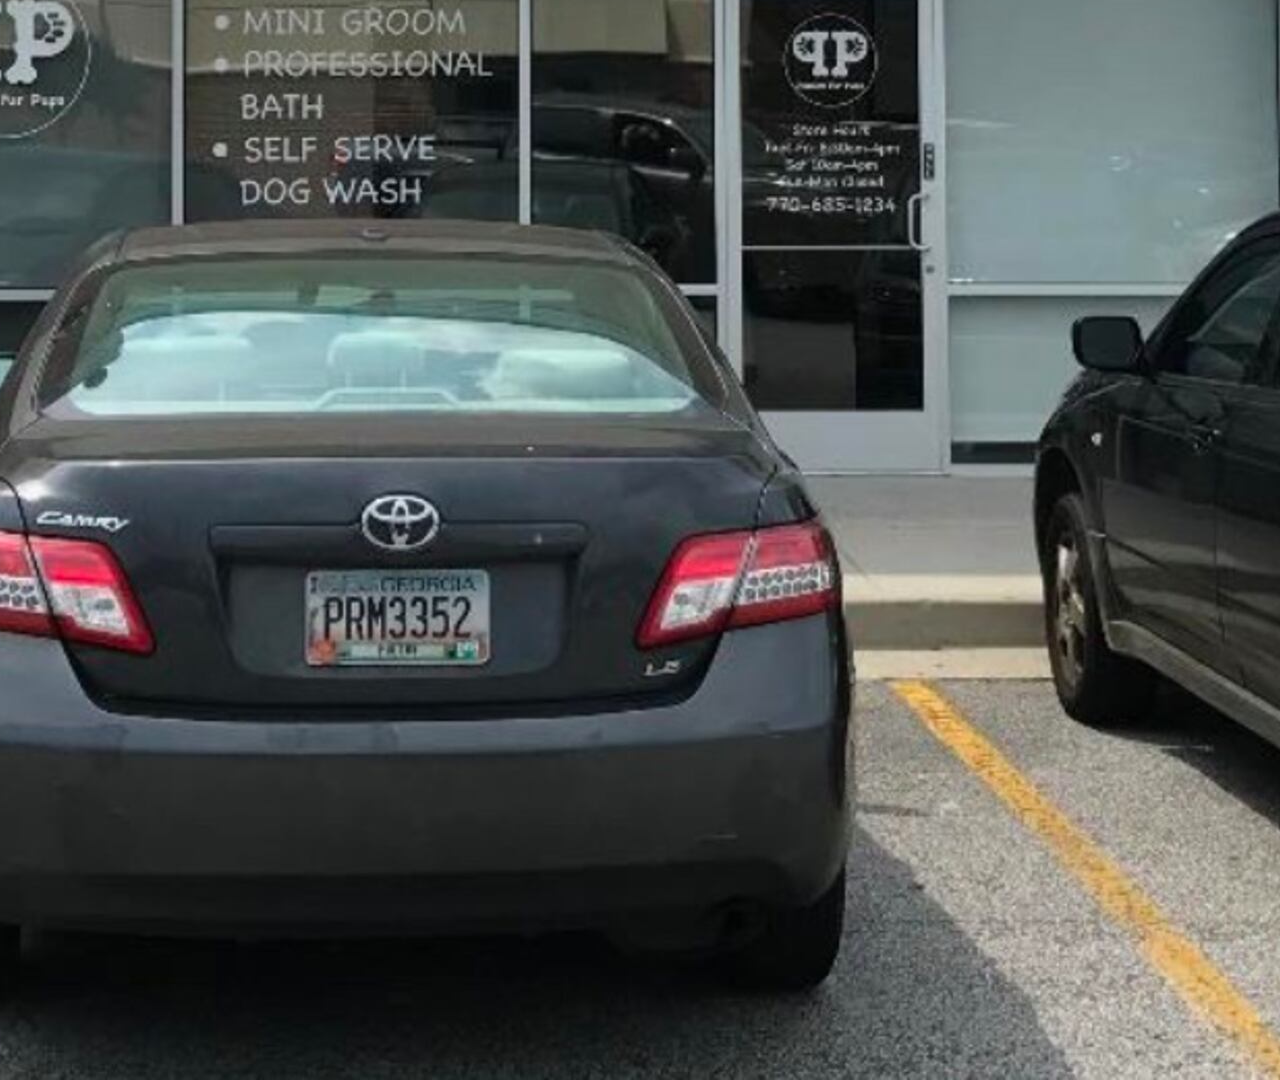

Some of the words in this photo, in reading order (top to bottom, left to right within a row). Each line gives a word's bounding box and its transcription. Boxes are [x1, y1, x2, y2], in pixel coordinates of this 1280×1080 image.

[243, 9, 326, 36] MINI
[341, 8, 467, 36] GROOM
[243, 50, 494, 78] PROFESSIONAL
[240, 92, 324, 120] BATH
[244, 136, 318, 164] SELF
[333, 134, 438, 164] SERVE
[240, 177, 311, 207] DOG
[323, 176, 423, 206] WASH
[766, 196, 897, 214] 770-685-1234
[323, 596, 472, 641] PRM3352
